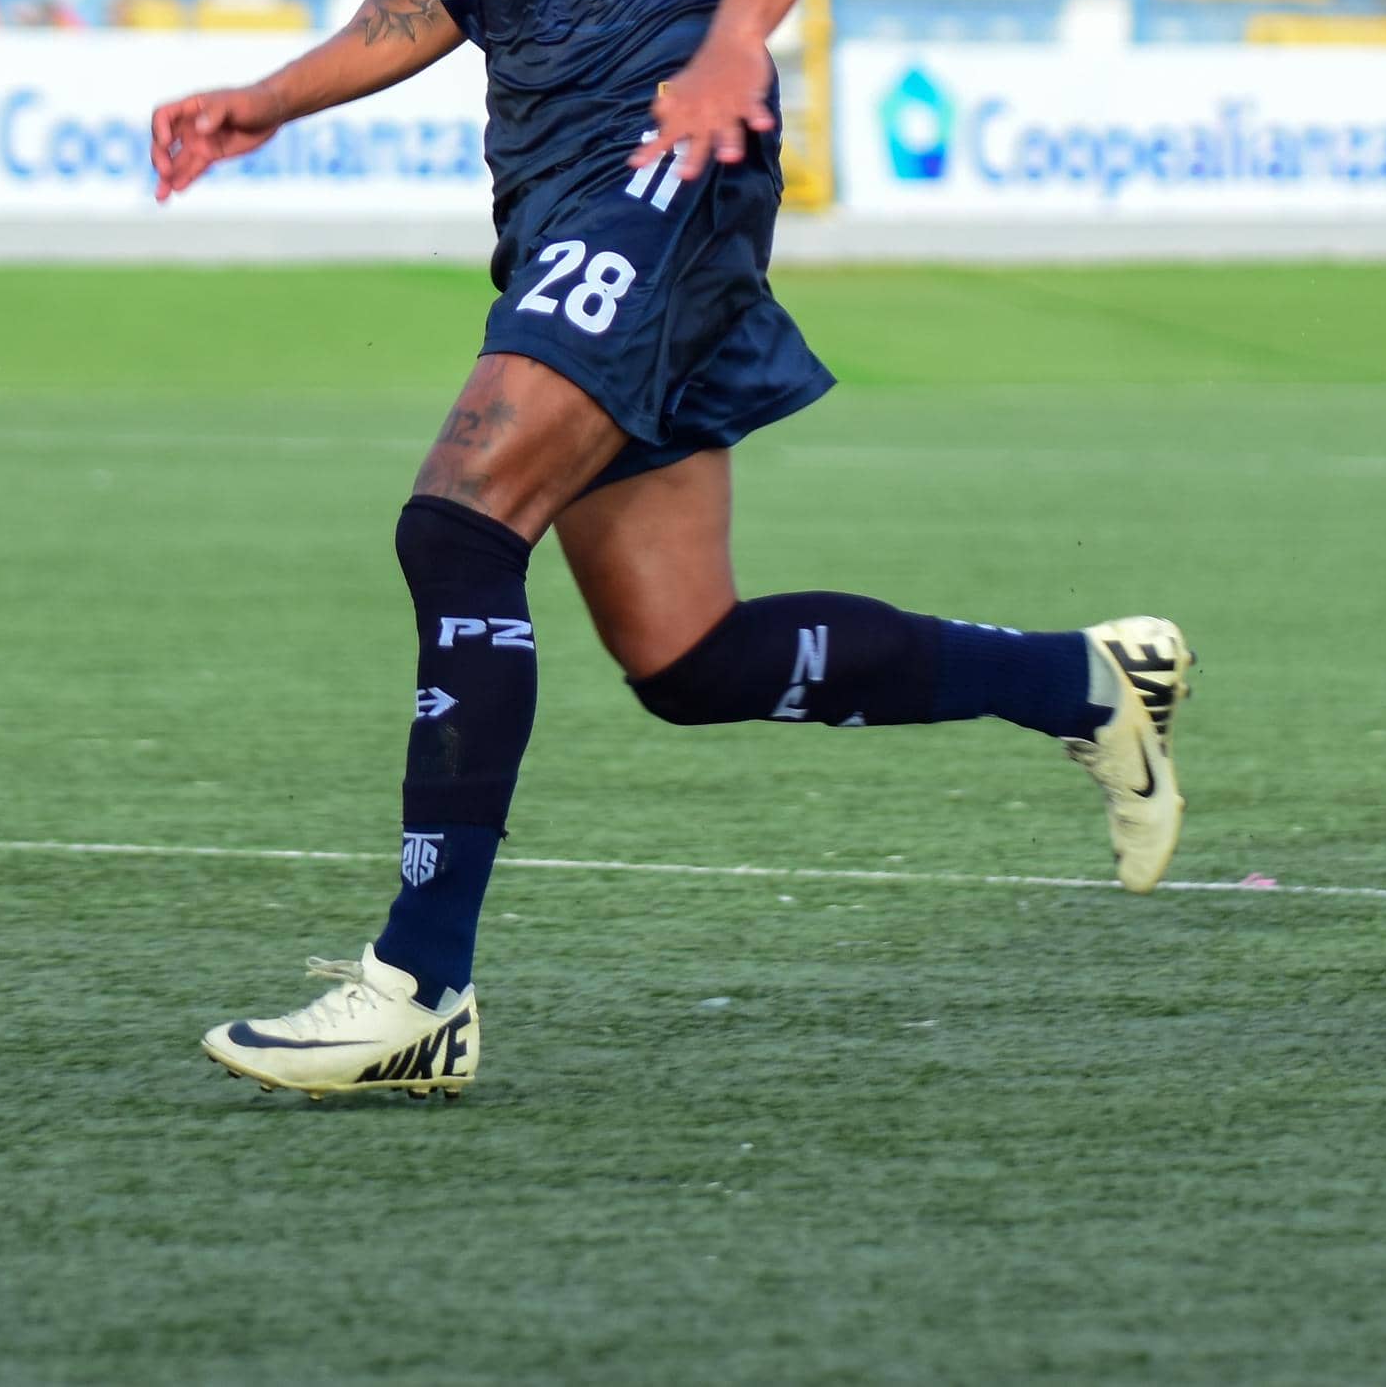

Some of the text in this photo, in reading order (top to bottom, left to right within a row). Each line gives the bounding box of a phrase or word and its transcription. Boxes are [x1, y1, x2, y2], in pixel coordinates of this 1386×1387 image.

[516, 240, 636, 333] 28
[438, 616, 536, 650] PZ
[355, 1007, 473, 1083] NIKE
